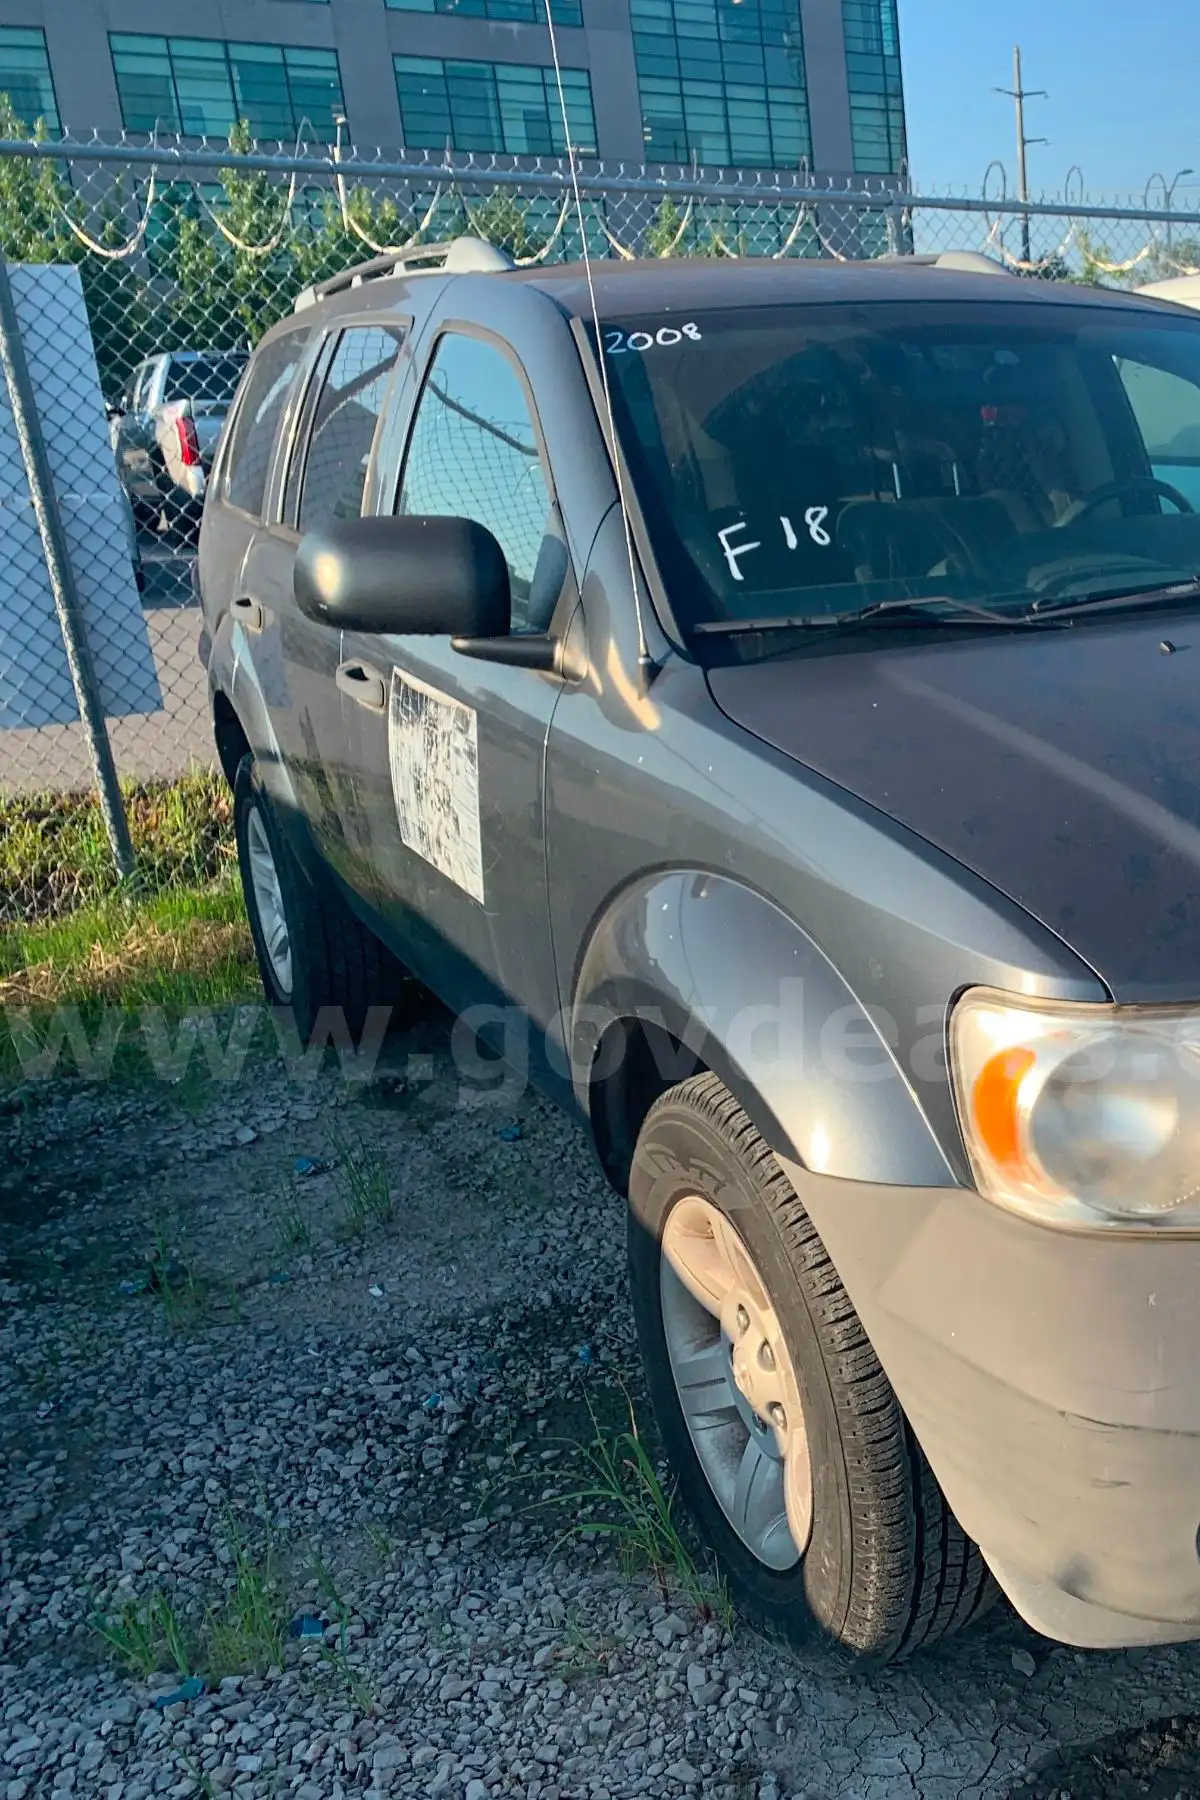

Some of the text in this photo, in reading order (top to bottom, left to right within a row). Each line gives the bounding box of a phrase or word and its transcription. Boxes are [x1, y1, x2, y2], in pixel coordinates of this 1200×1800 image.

[604, 322, 702, 353] 2008
[717, 505, 831, 581] F 18
